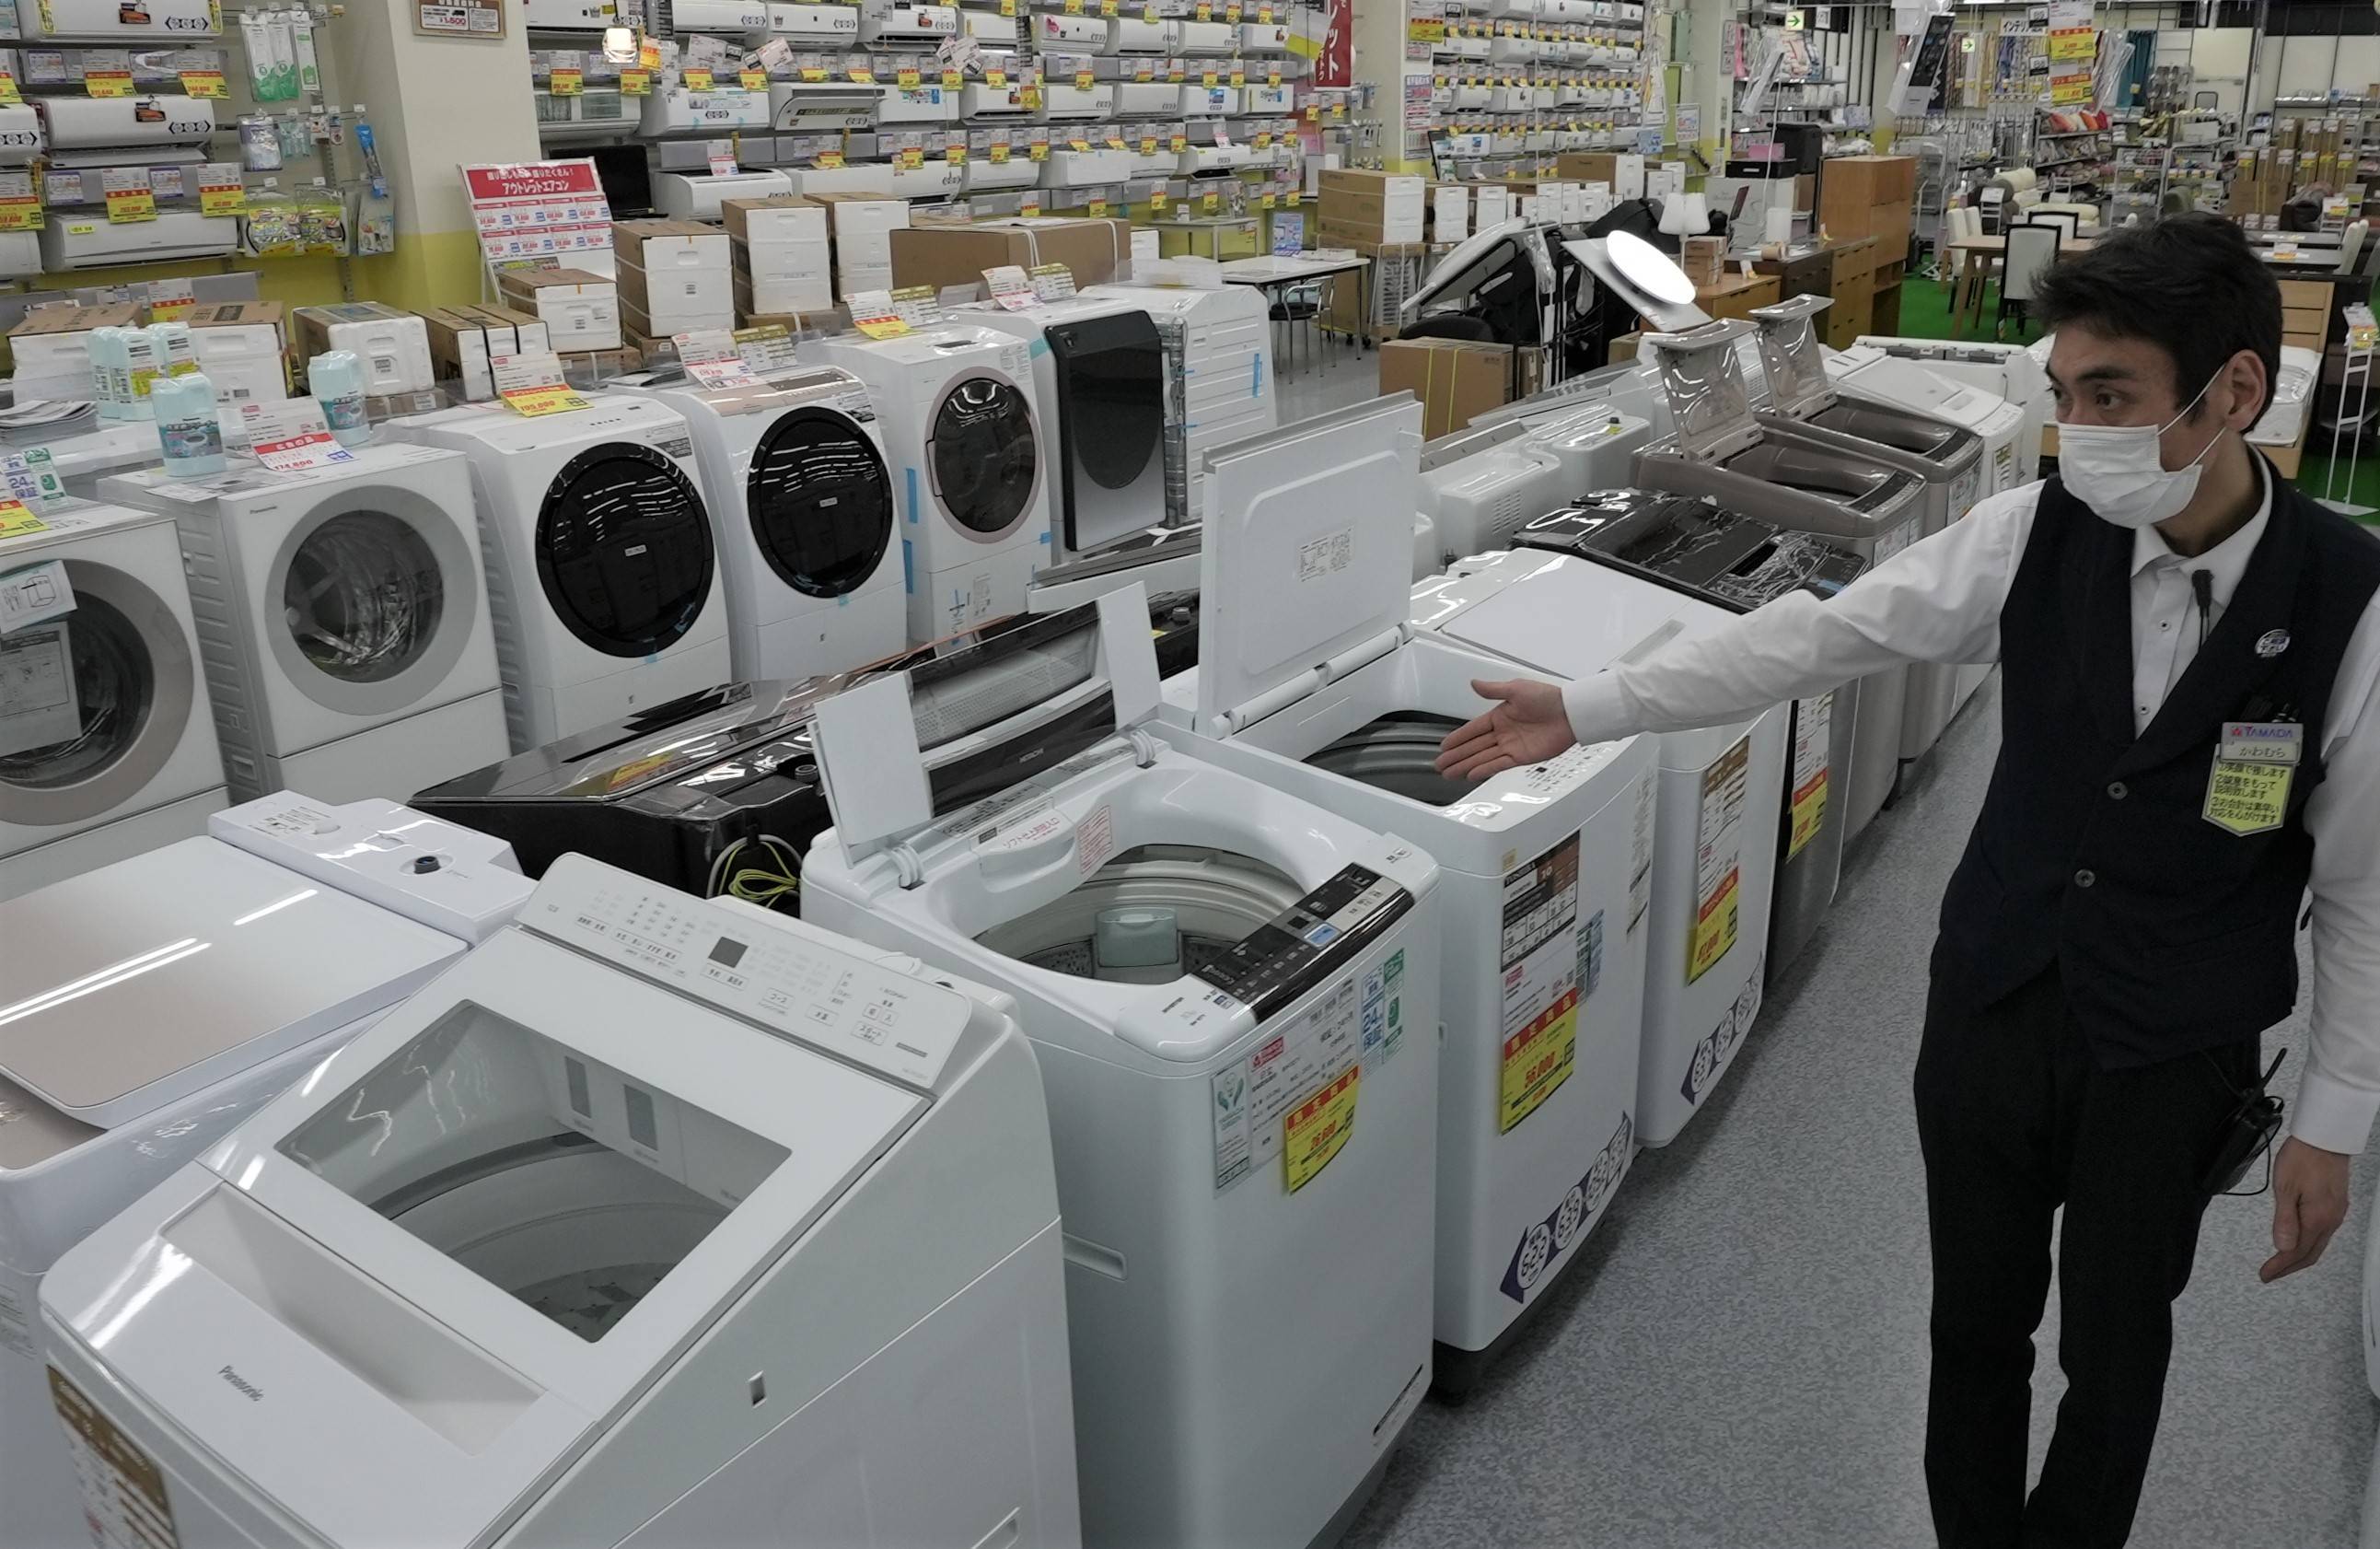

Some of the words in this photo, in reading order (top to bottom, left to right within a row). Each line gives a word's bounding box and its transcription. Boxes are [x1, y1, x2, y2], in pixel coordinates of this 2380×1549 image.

[2238, 746, 2285, 759] かわむら
[218, 1364, 264, 1403] Panasonic
